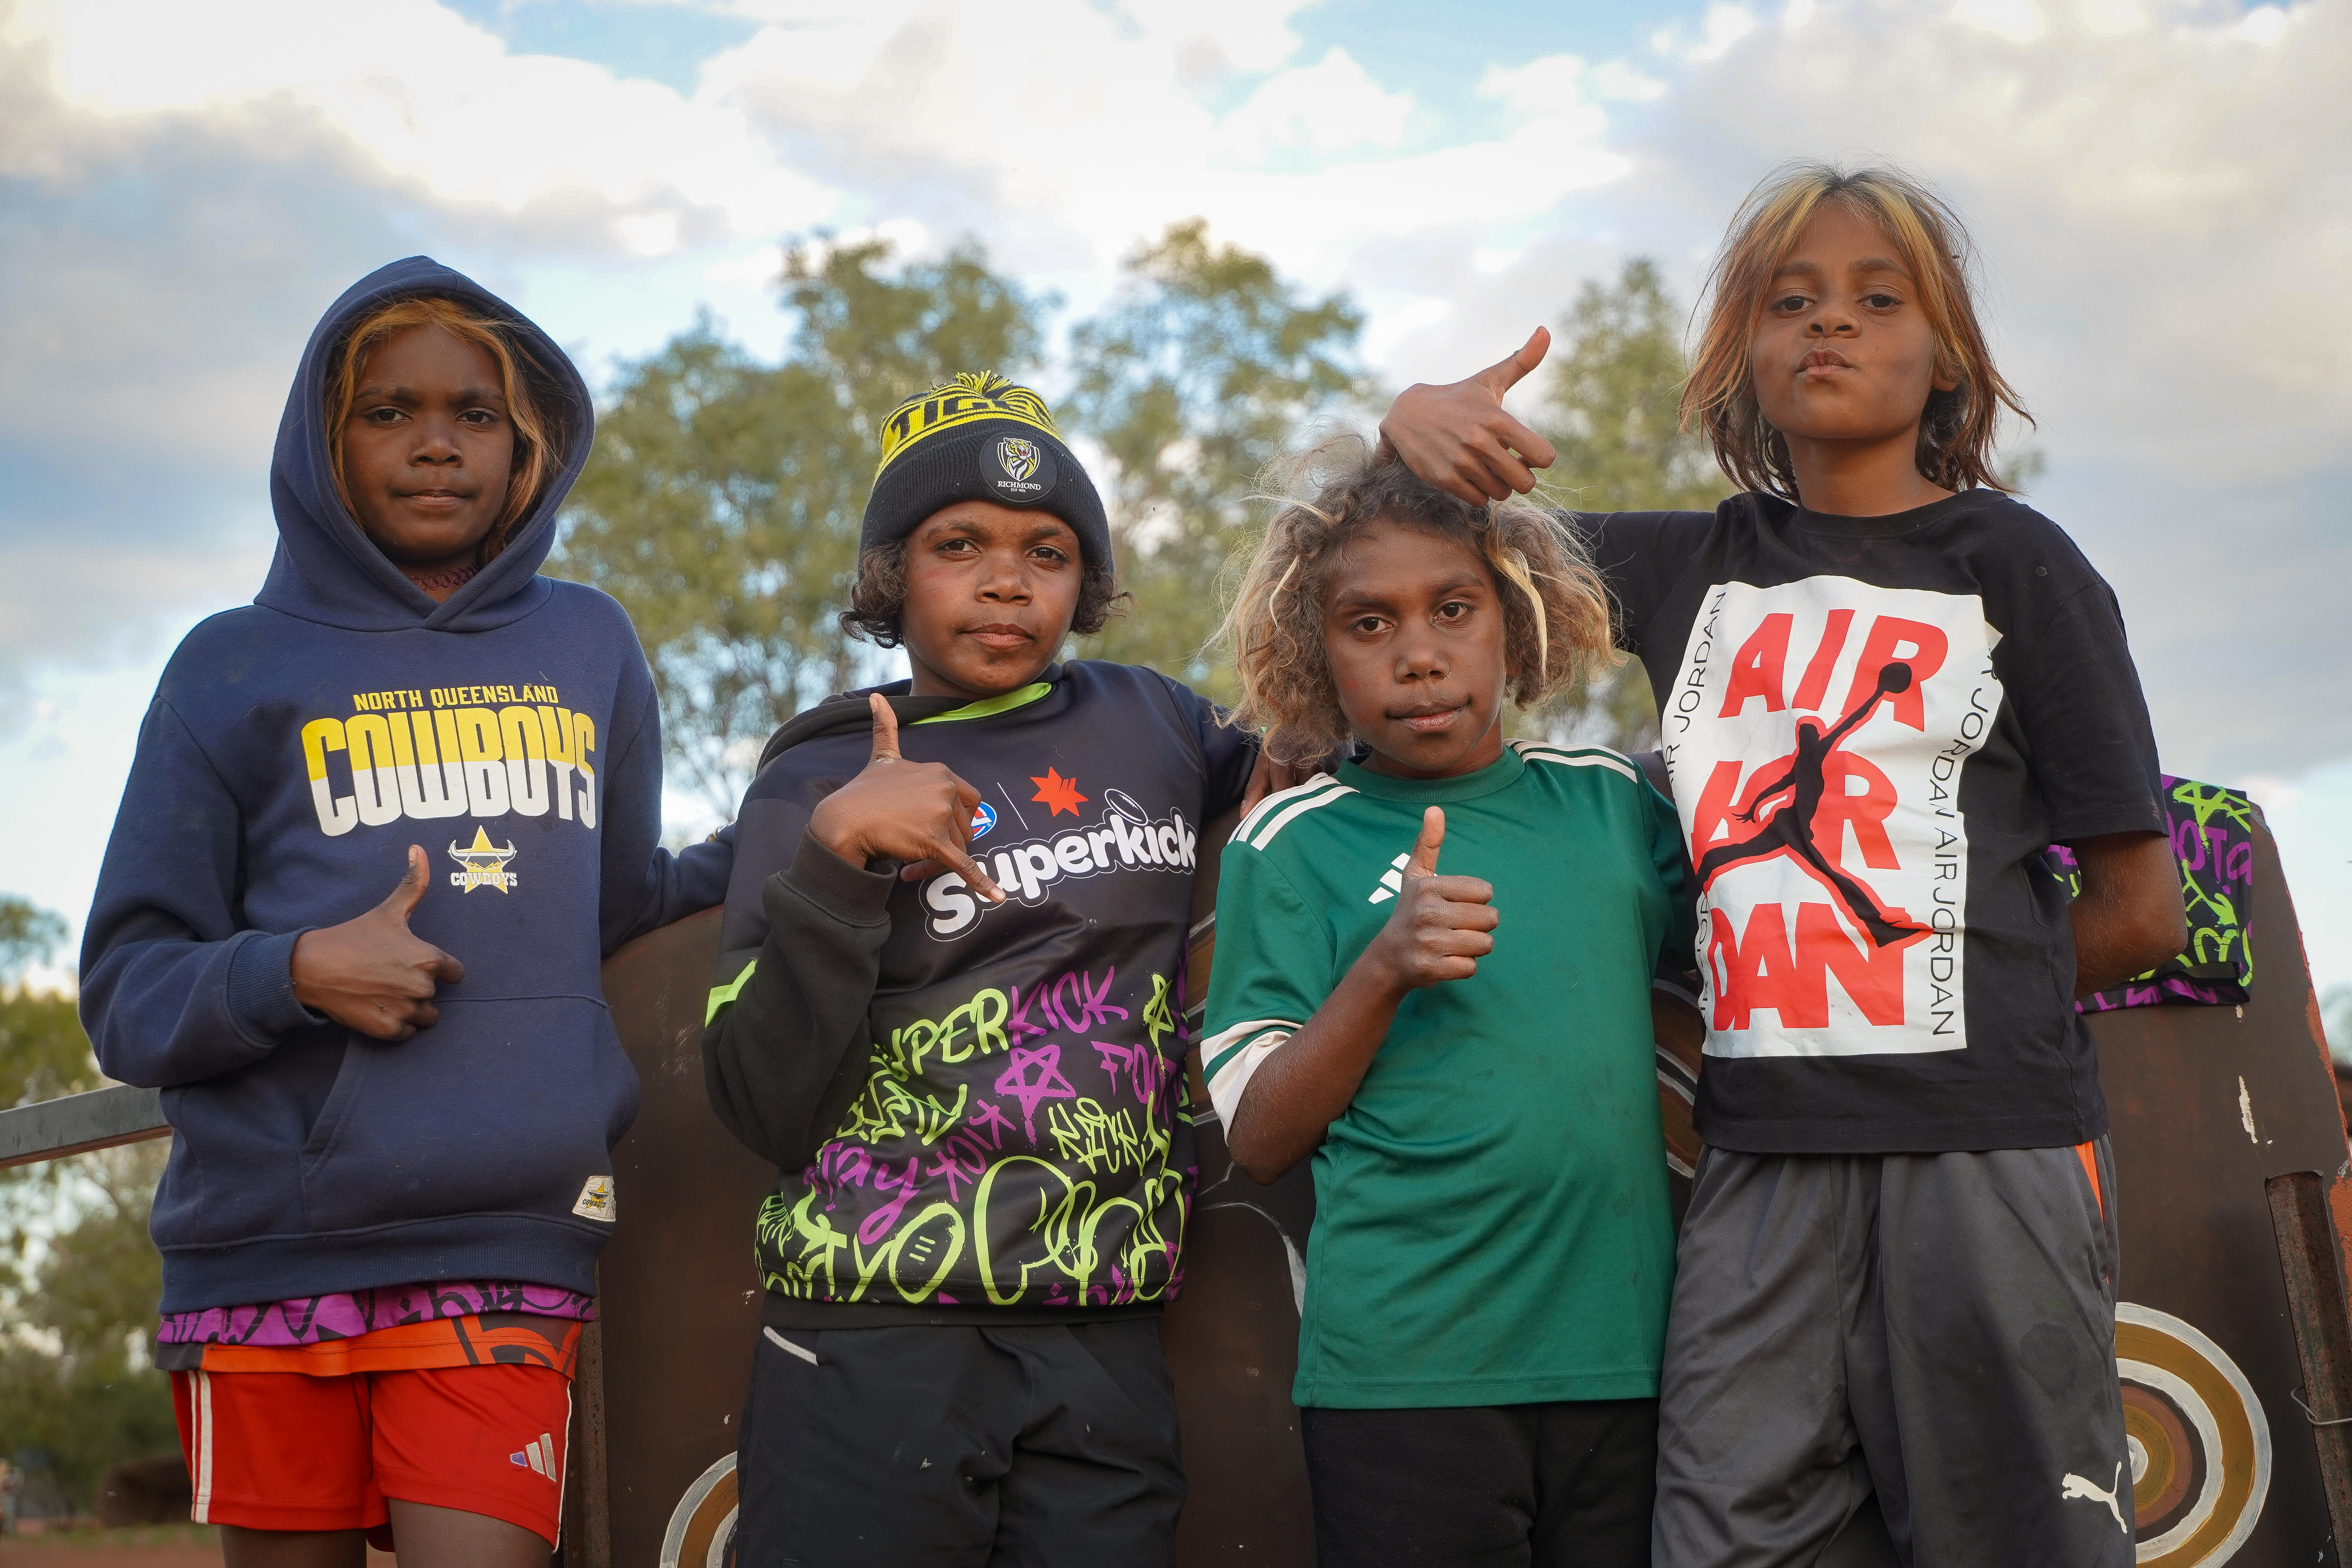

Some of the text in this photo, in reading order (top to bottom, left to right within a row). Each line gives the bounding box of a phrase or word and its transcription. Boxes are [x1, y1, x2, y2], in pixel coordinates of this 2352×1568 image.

[997, 481, 1041, 490] RICHMOND
[353, 685, 559, 711] NORTH QUEENSLAND
[1673, 592, 1726, 733] JORDAN
[1718, 608, 1949, 732] AIR
[301, 705, 596, 836] COWBOYS
[450, 871, 517, 887] COWBOYS
[926, 814, 1196, 934] Superkick
[1929, 687, 1988, 1035] JORDAN AIR JORDAN
[1708, 901, 1905, 1031] DAN
[582, 1198, 607, 1208] COWBOYS
